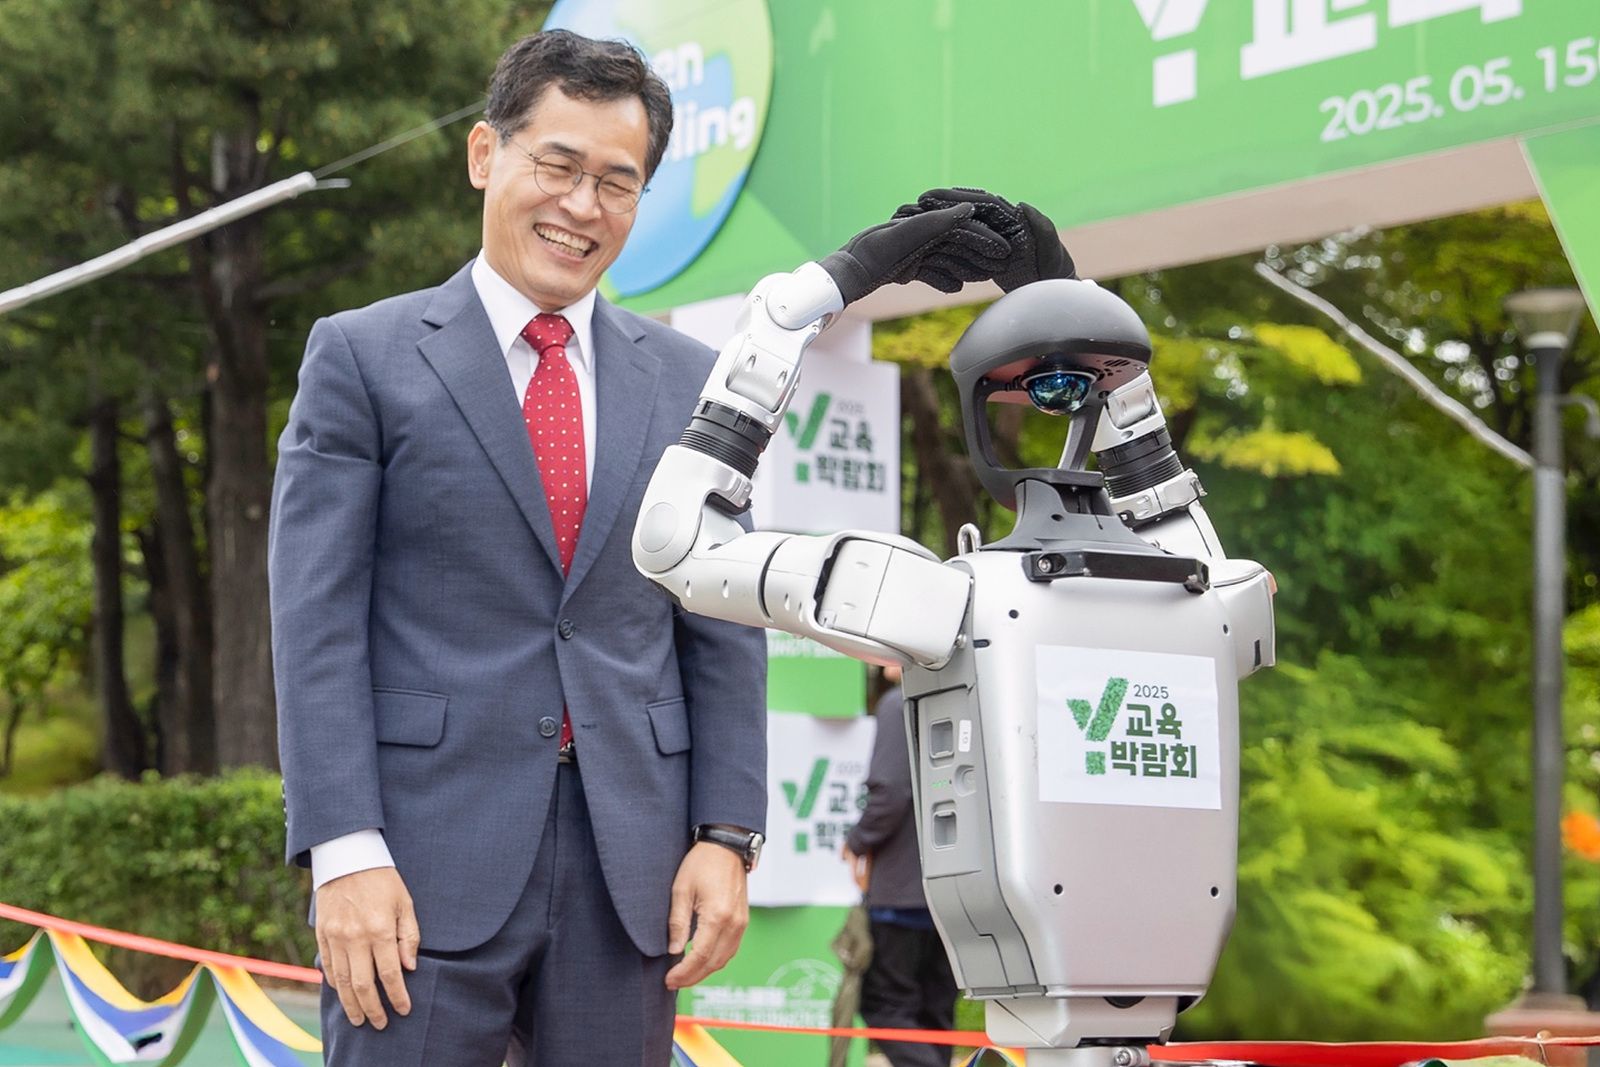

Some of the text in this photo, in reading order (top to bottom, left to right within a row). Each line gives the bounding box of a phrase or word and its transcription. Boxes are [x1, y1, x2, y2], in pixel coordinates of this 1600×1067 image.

[1319, 36, 1600, 142] 2025. 05. 15
[1133, 684, 1169, 699] 2025
[1126, 703, 1182, 739] 교육
[1110, 741, 1197, 778] 박람회
